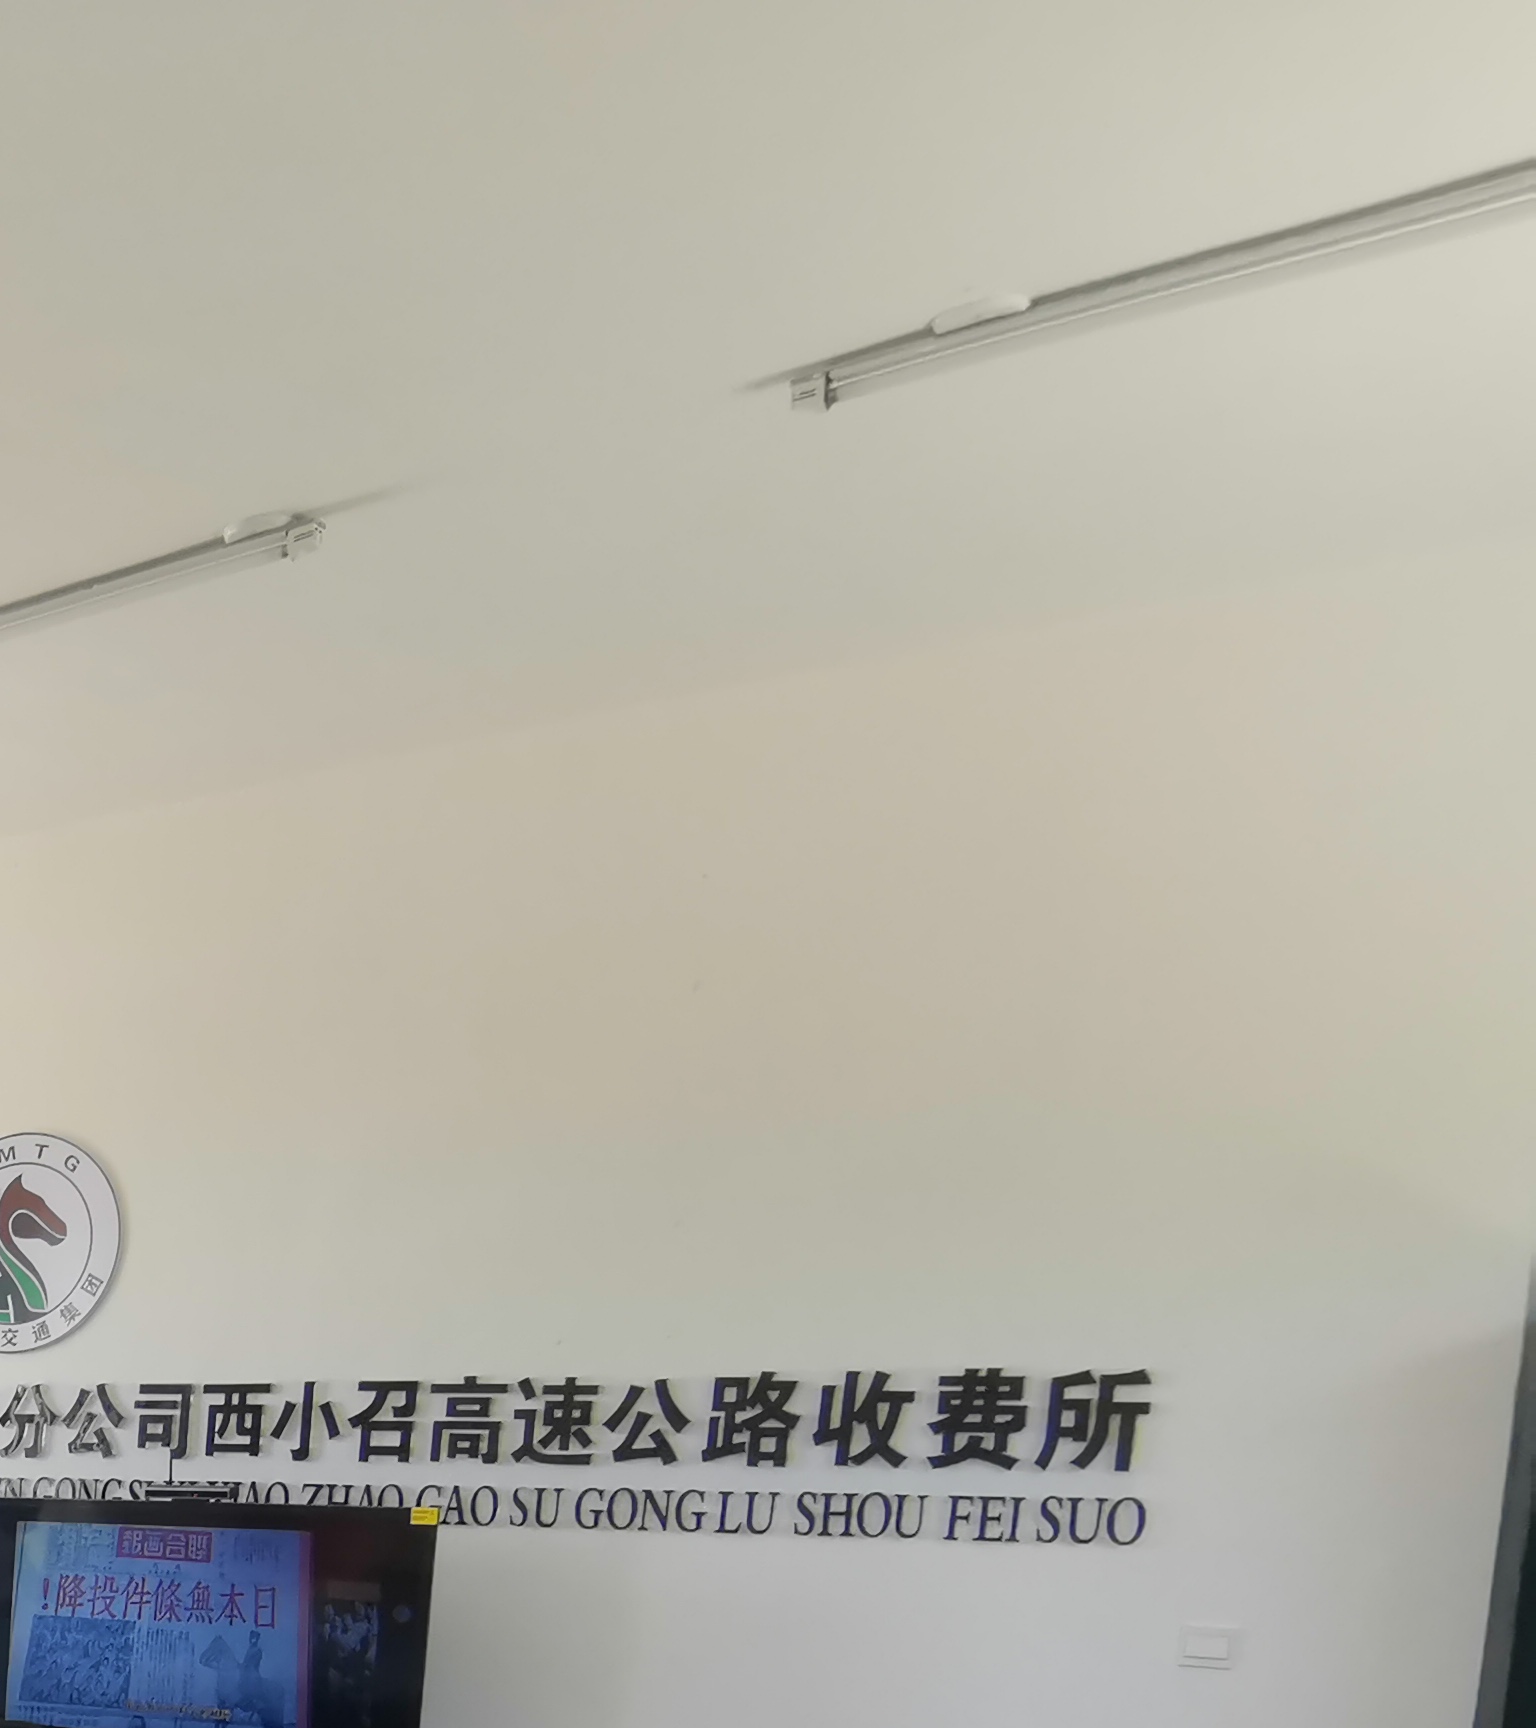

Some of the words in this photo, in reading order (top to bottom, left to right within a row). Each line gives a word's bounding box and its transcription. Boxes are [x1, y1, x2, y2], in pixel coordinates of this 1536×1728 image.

[415, 1484, 499, 1526] GAO
[509, 1486, 565, 1528] SU
[574, 1487, 708, 1533] GONG
[714, 1489, 781, 1536] LU
[793, 1490, 929, 1540] SHOU
[942, 1494, 1026, 1544] FEI
[1035, 1495, 1147, 1547] SUO
